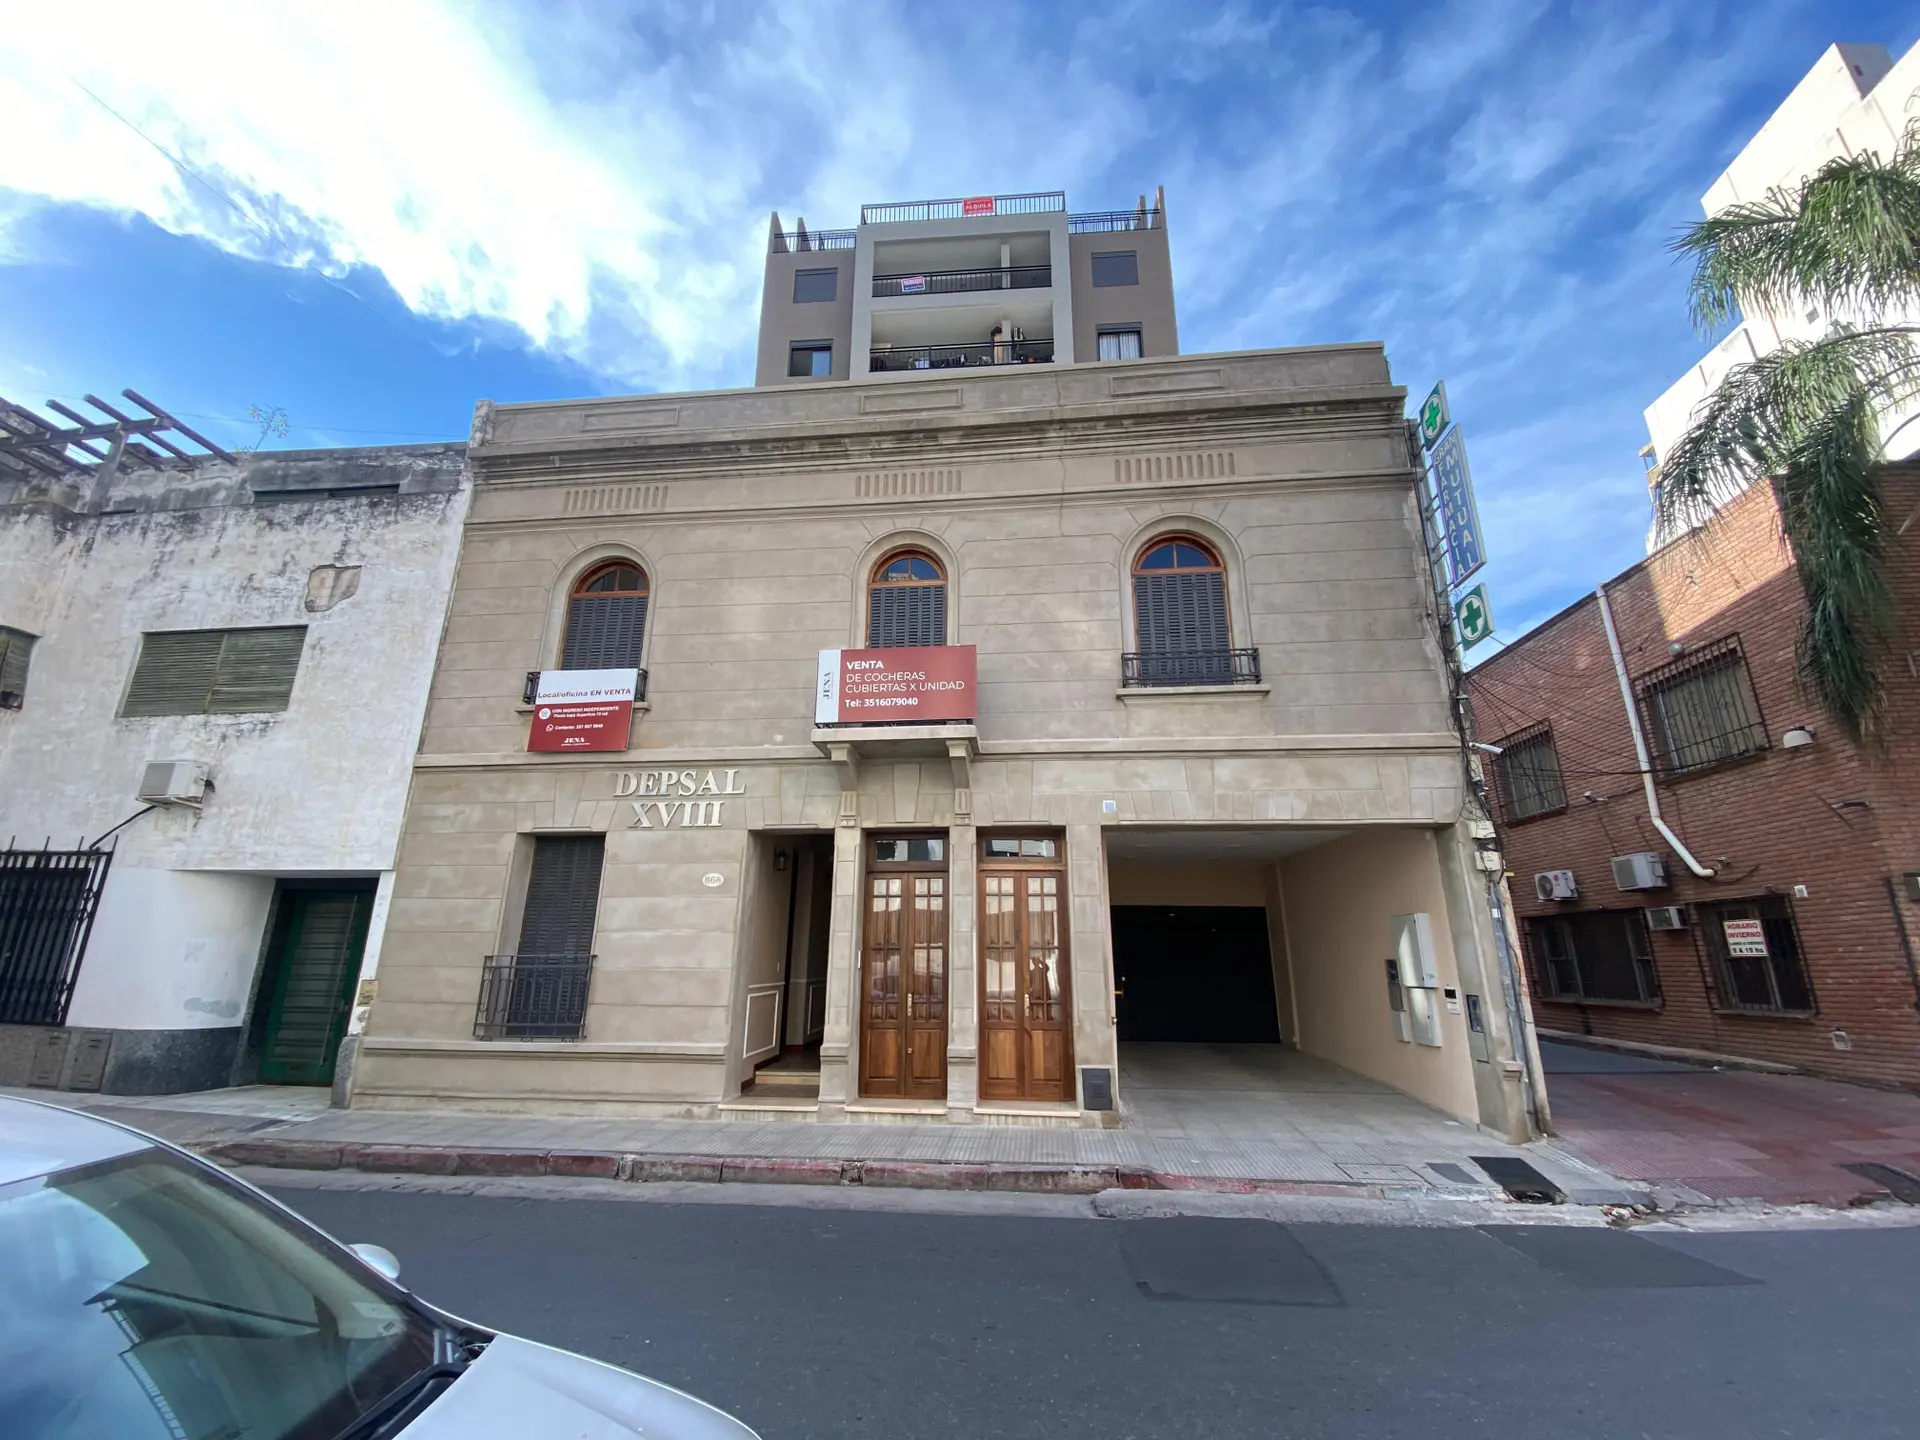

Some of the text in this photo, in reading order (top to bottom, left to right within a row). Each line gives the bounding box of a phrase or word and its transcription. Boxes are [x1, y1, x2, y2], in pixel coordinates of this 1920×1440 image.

[1435, 436, 1455, 465] GRAN
[1439, 463, 1466, 579] FARMACIA
[1446, 447, 1475, 568] MUTUAL
[846, 660, 884, 670] VENTA
[846, 671, 926, 683] DE COCHERAS
[823, 671, 831, 700] JENA
[845, 680, 965, 693] CUBIERTAS X UNIDAD
[845, 697, 918, 707] Tel: 3516079040
[613, 769, 746, 797] DEPSAL
[628, 801, 725, 829] XVIII
[705, 876, 721, 884] 868
